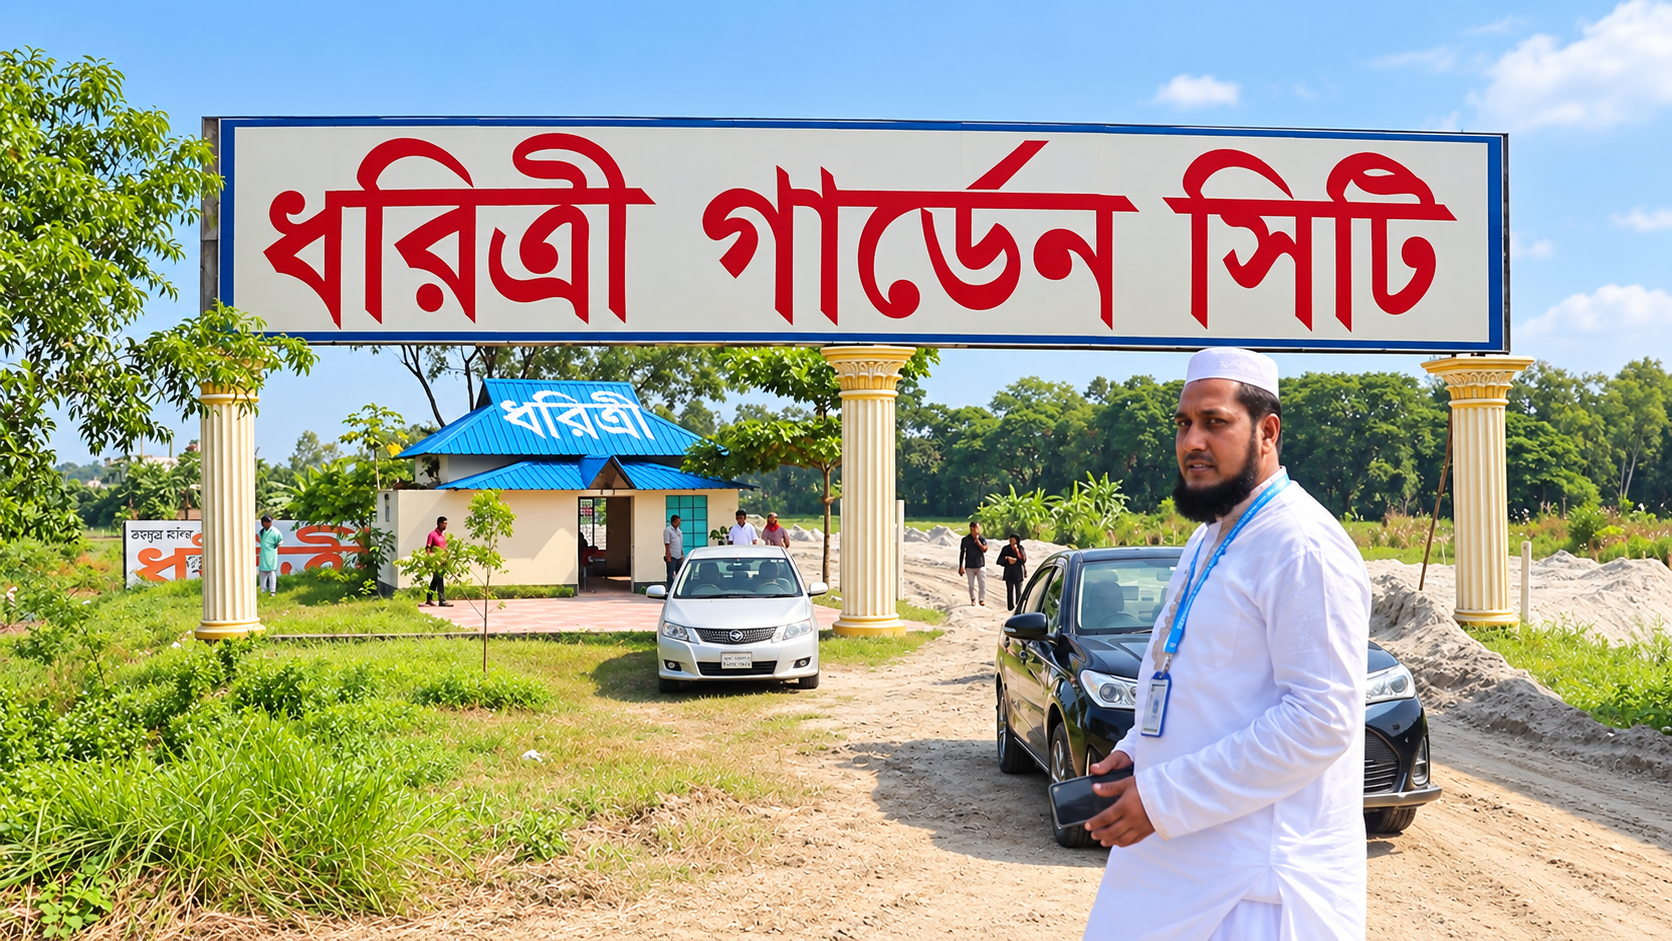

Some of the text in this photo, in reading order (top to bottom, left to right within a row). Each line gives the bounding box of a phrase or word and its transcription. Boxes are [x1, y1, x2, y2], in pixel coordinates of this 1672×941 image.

[263, 132, 1458, 332] ধরিত্রী গার্ডেন সিটি
[500, 390, 655, 440] ধরিত্রী
